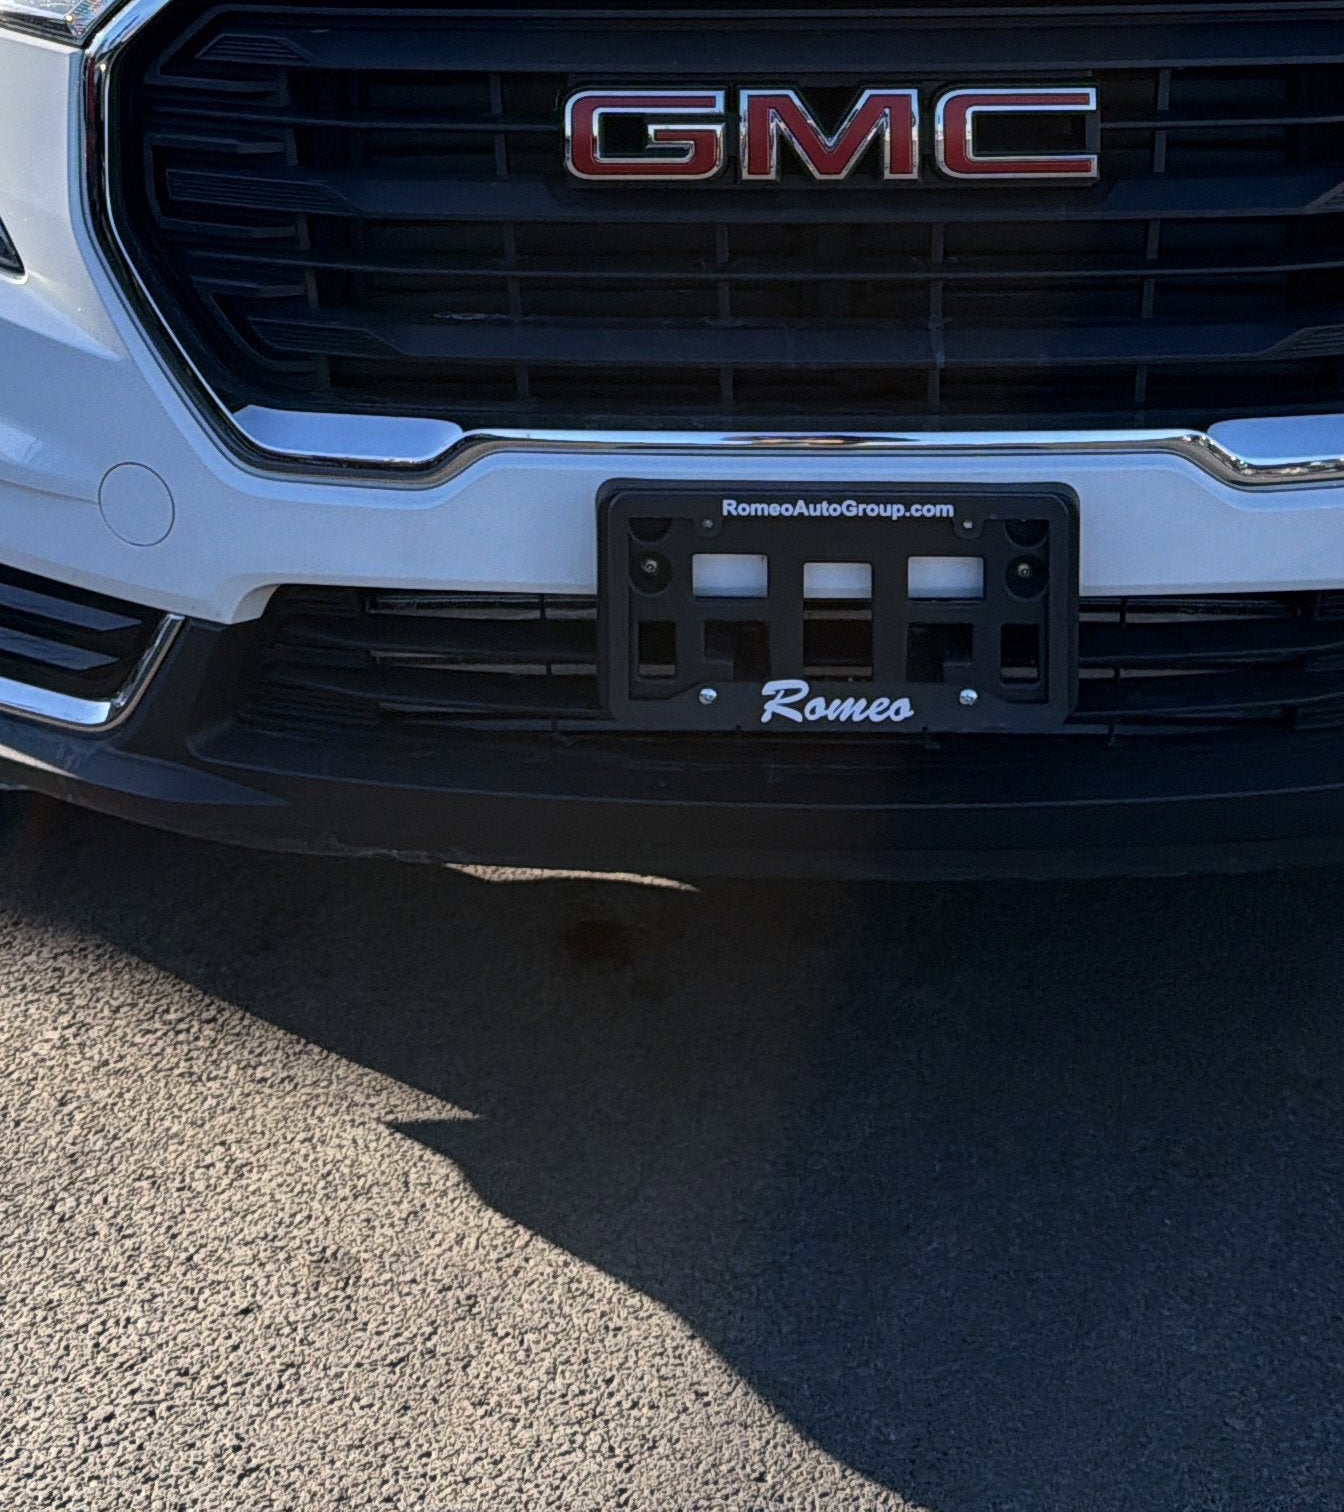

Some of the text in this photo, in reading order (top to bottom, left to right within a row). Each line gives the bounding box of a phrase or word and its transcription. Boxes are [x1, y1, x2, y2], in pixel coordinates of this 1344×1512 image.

[564, 88, 1099, 181] GMC
[722, 499, 954, 520] RomeoAutoGroup.com
[761, 679, 915, 723] Romeo
